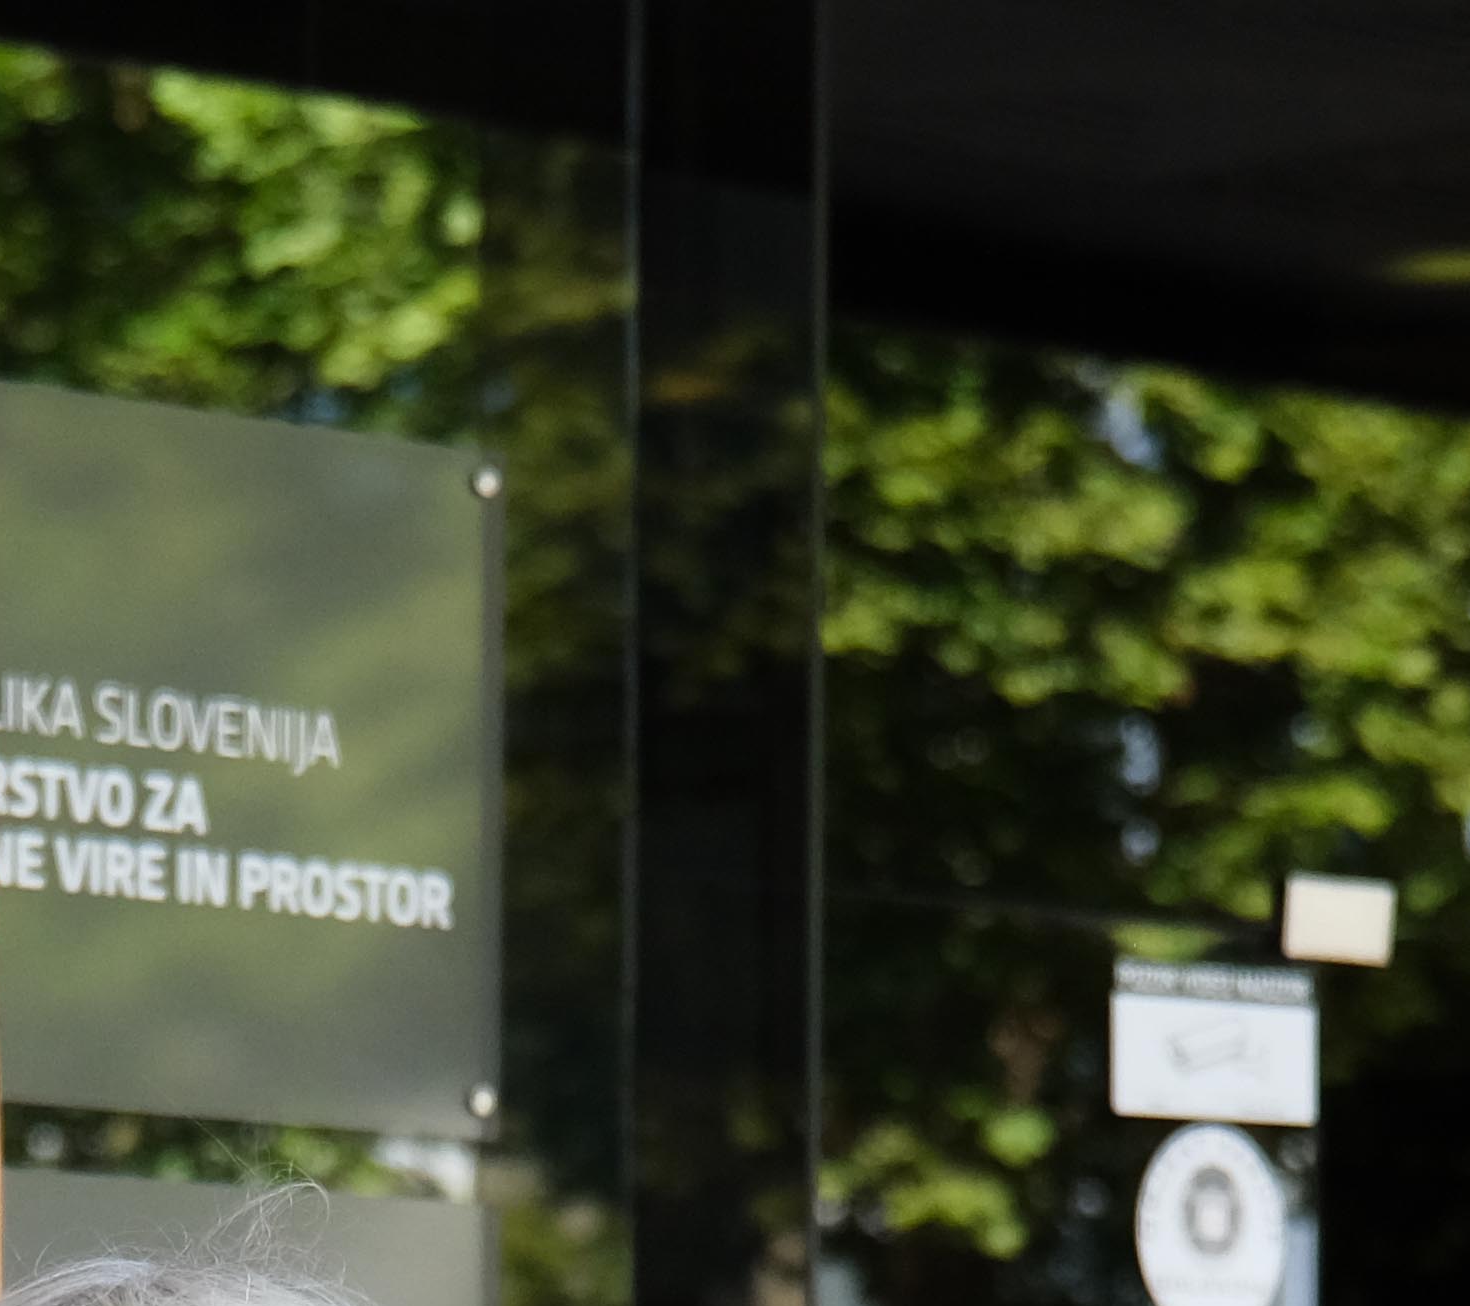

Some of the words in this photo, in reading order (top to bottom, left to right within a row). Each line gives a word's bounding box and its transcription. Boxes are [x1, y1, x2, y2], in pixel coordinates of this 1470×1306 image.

[92, 680, 341, 777] SLOVENIJA
[141, 771, 210, 836] ZA
[53, 834, 166, 902] VIRE
[175, 847, 228, 908] IN
[236, 851, 454, 931] PROSTOR
